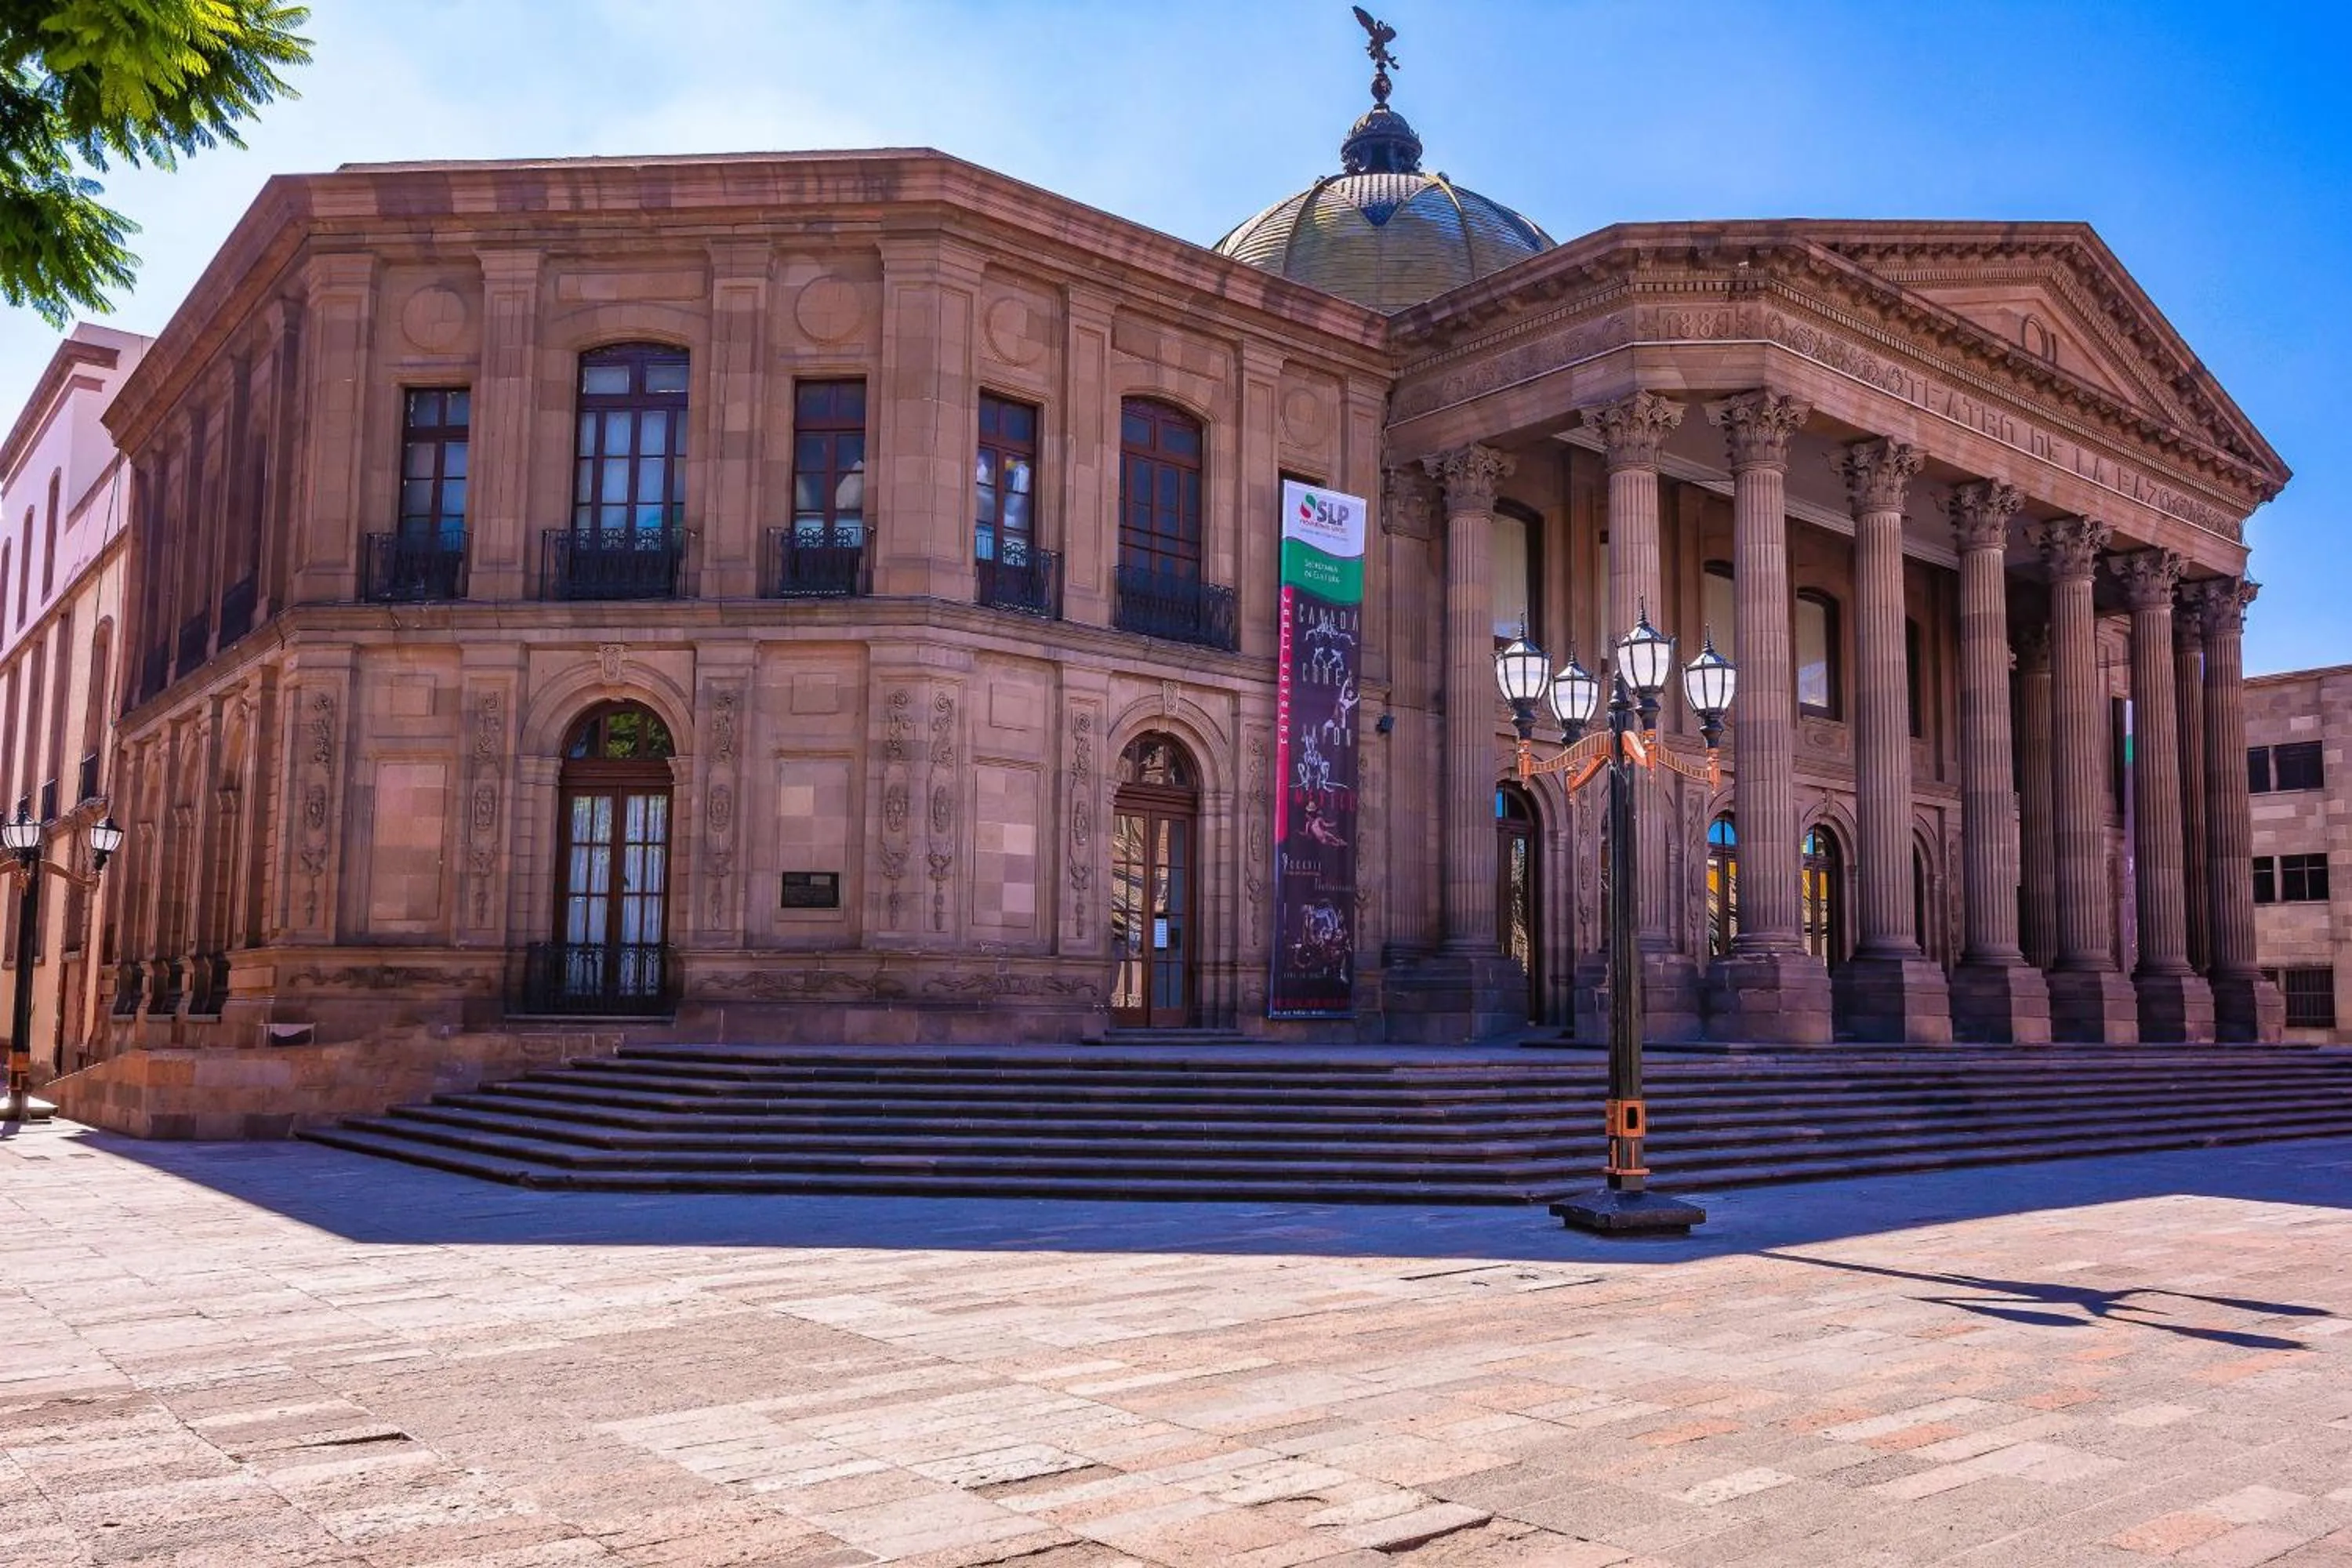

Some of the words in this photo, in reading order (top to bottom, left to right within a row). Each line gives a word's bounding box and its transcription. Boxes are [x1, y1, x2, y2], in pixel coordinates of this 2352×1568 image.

[1663, 311, 1731, 339] 1889
[1905, 370, 2014, 444] TEATRO
[2031, 427, 2062, 463] DE
[2075, 448, 2104, 485] LA
[2118, 467, 2157, 506] PAZ
[1317, 500, 1349, 525] SLP
